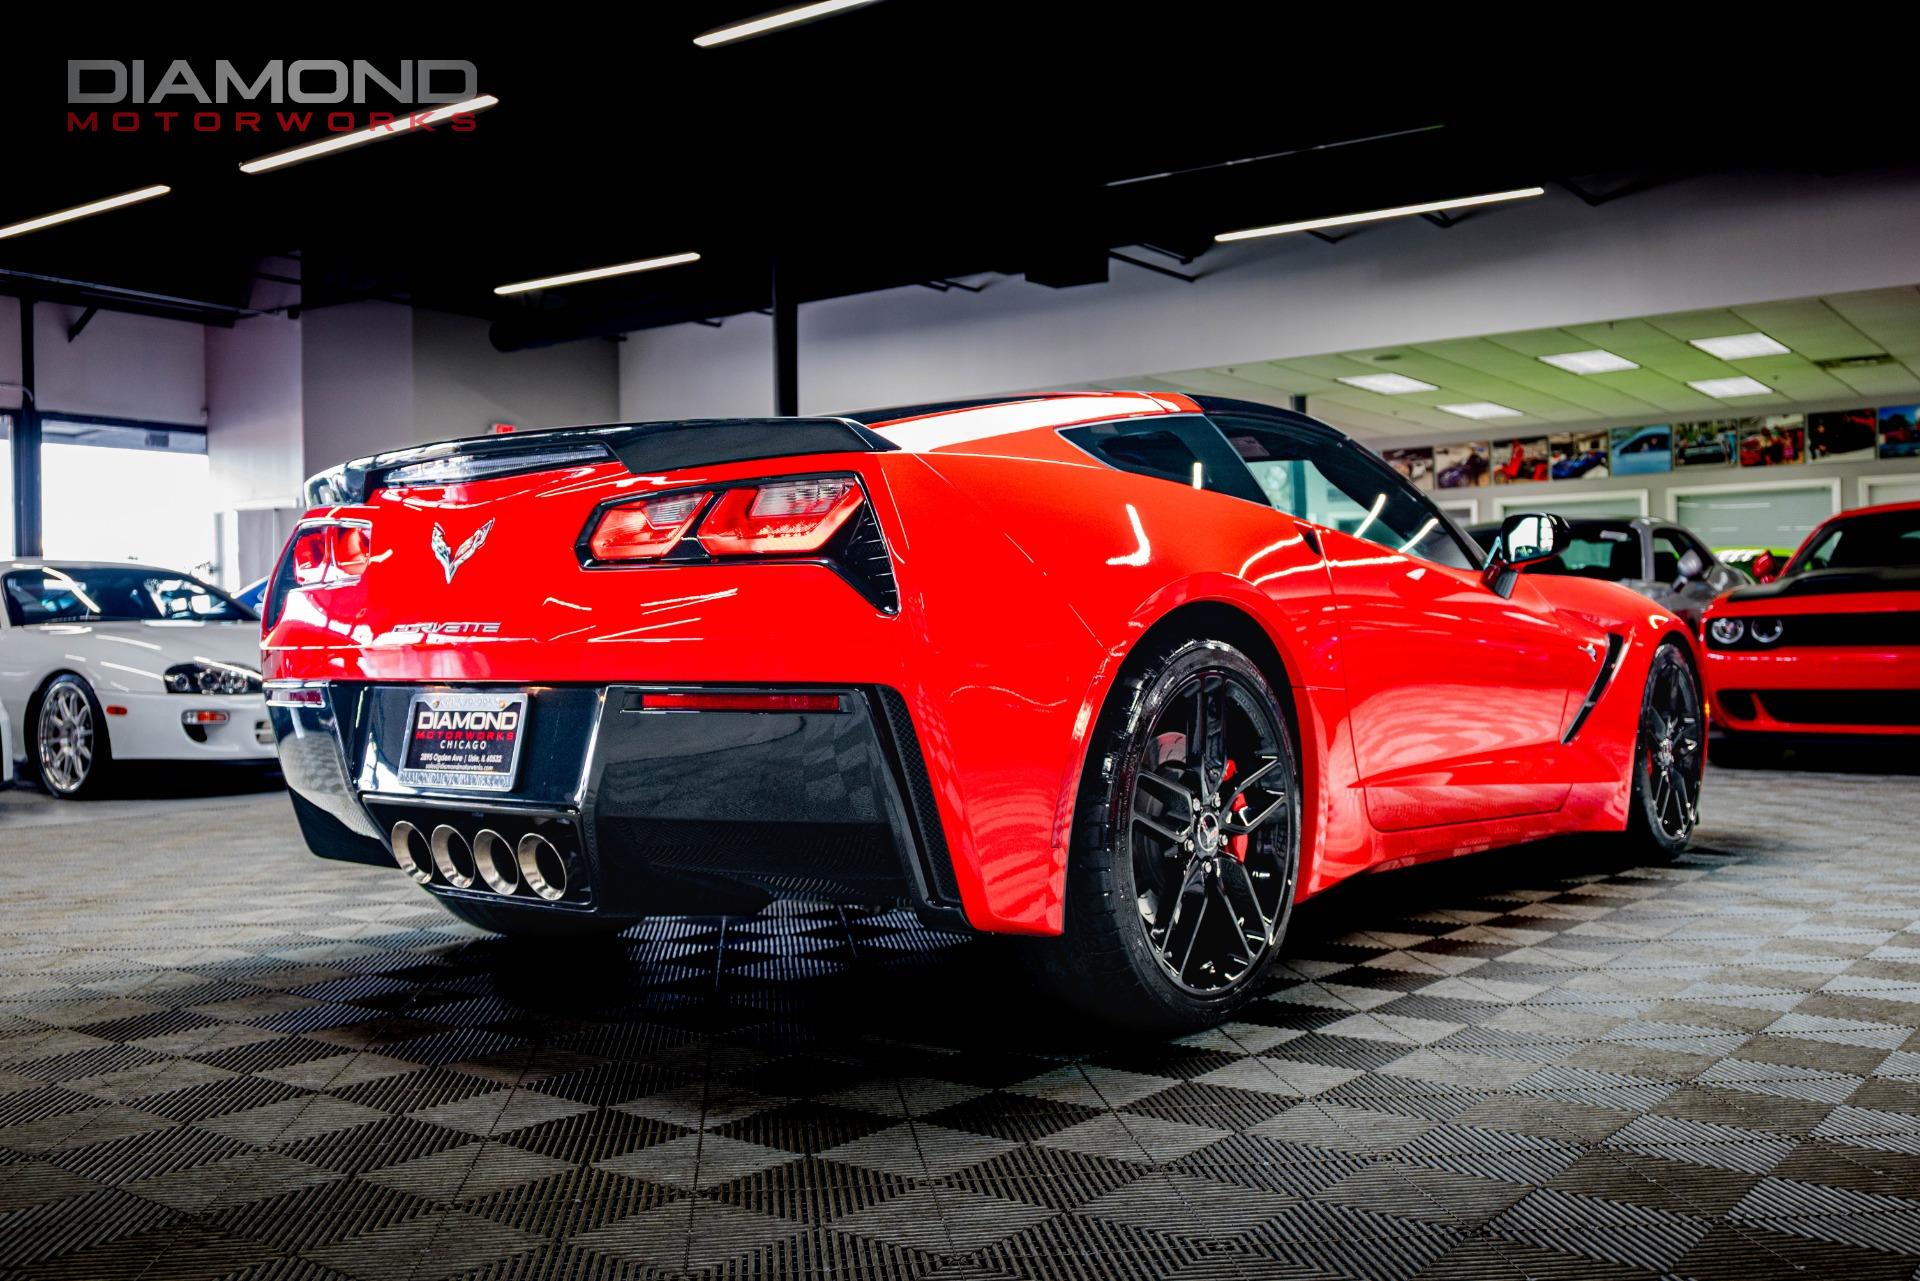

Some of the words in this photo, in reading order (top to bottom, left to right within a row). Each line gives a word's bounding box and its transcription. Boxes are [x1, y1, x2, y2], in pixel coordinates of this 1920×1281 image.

[392, 621, 502, 634] CORVETTE
[417, 711, 518, 730] DIAMOND
[415, 730, 515, 741] MOTORWORKS
[439, 740, 487, 750] CHICAGO
[433, 753, 451, 762] Ogden
[451, 754, 463, 762] Ave
